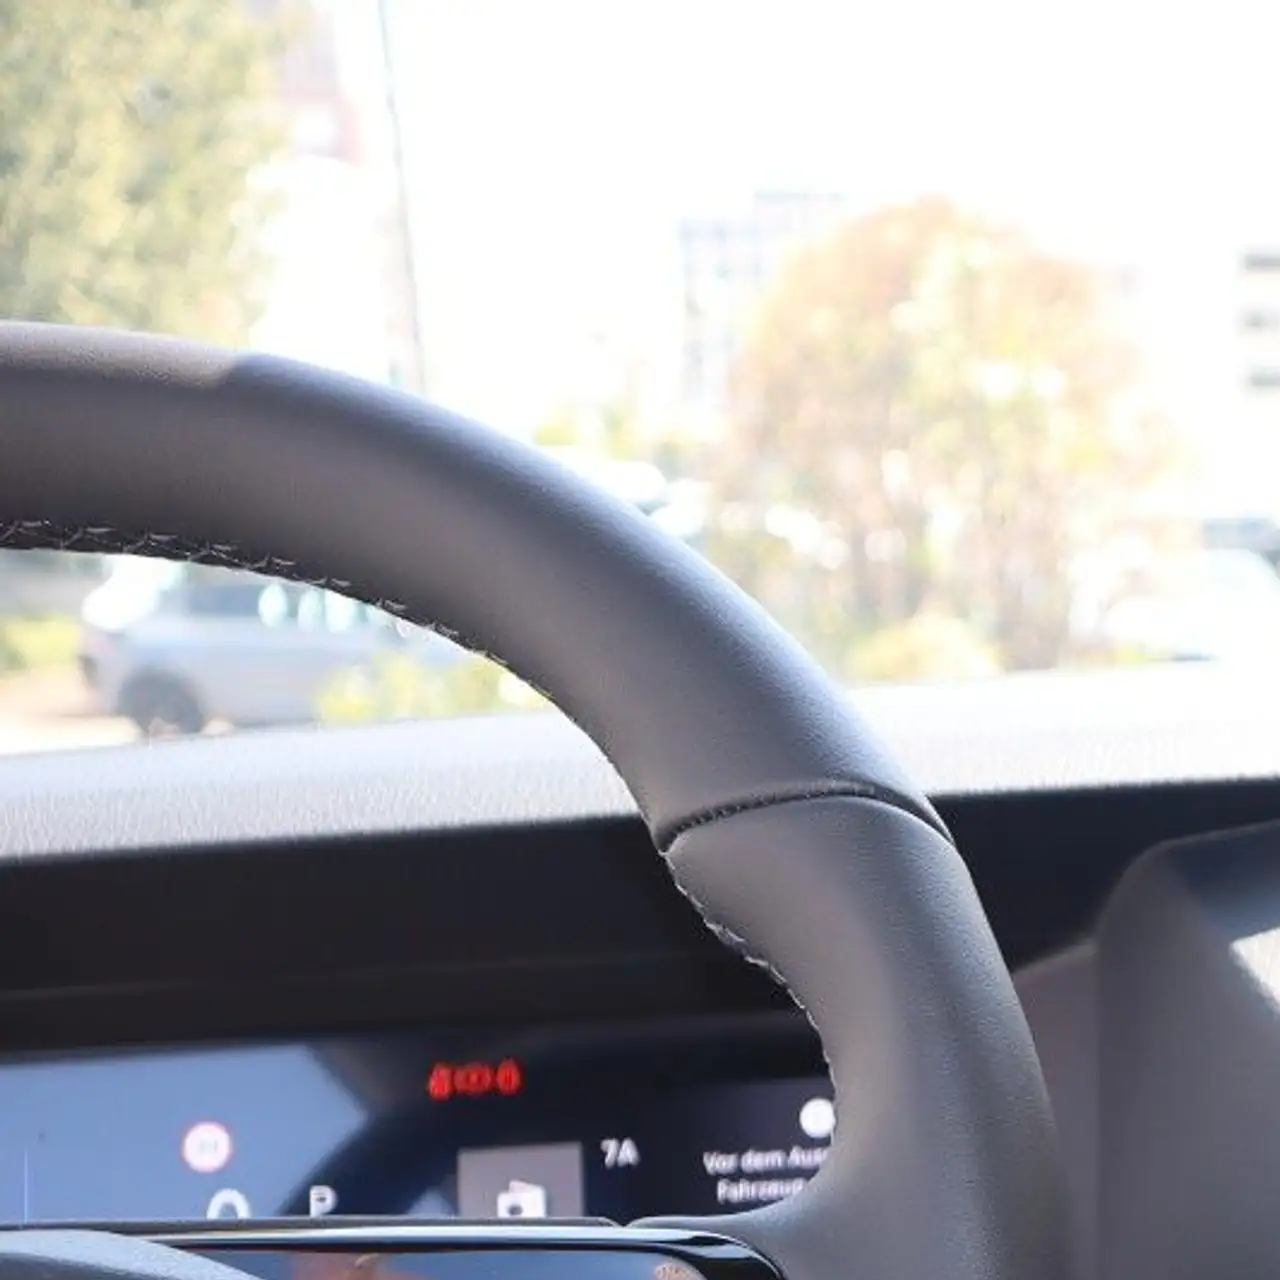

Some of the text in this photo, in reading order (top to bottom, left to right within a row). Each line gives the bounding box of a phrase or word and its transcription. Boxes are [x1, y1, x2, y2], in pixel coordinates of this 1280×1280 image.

[600, 1137, 640, 1169] 7A
[703, 1151, 739, 1175] Vor
[741, 1149, 787, 1173] dem
